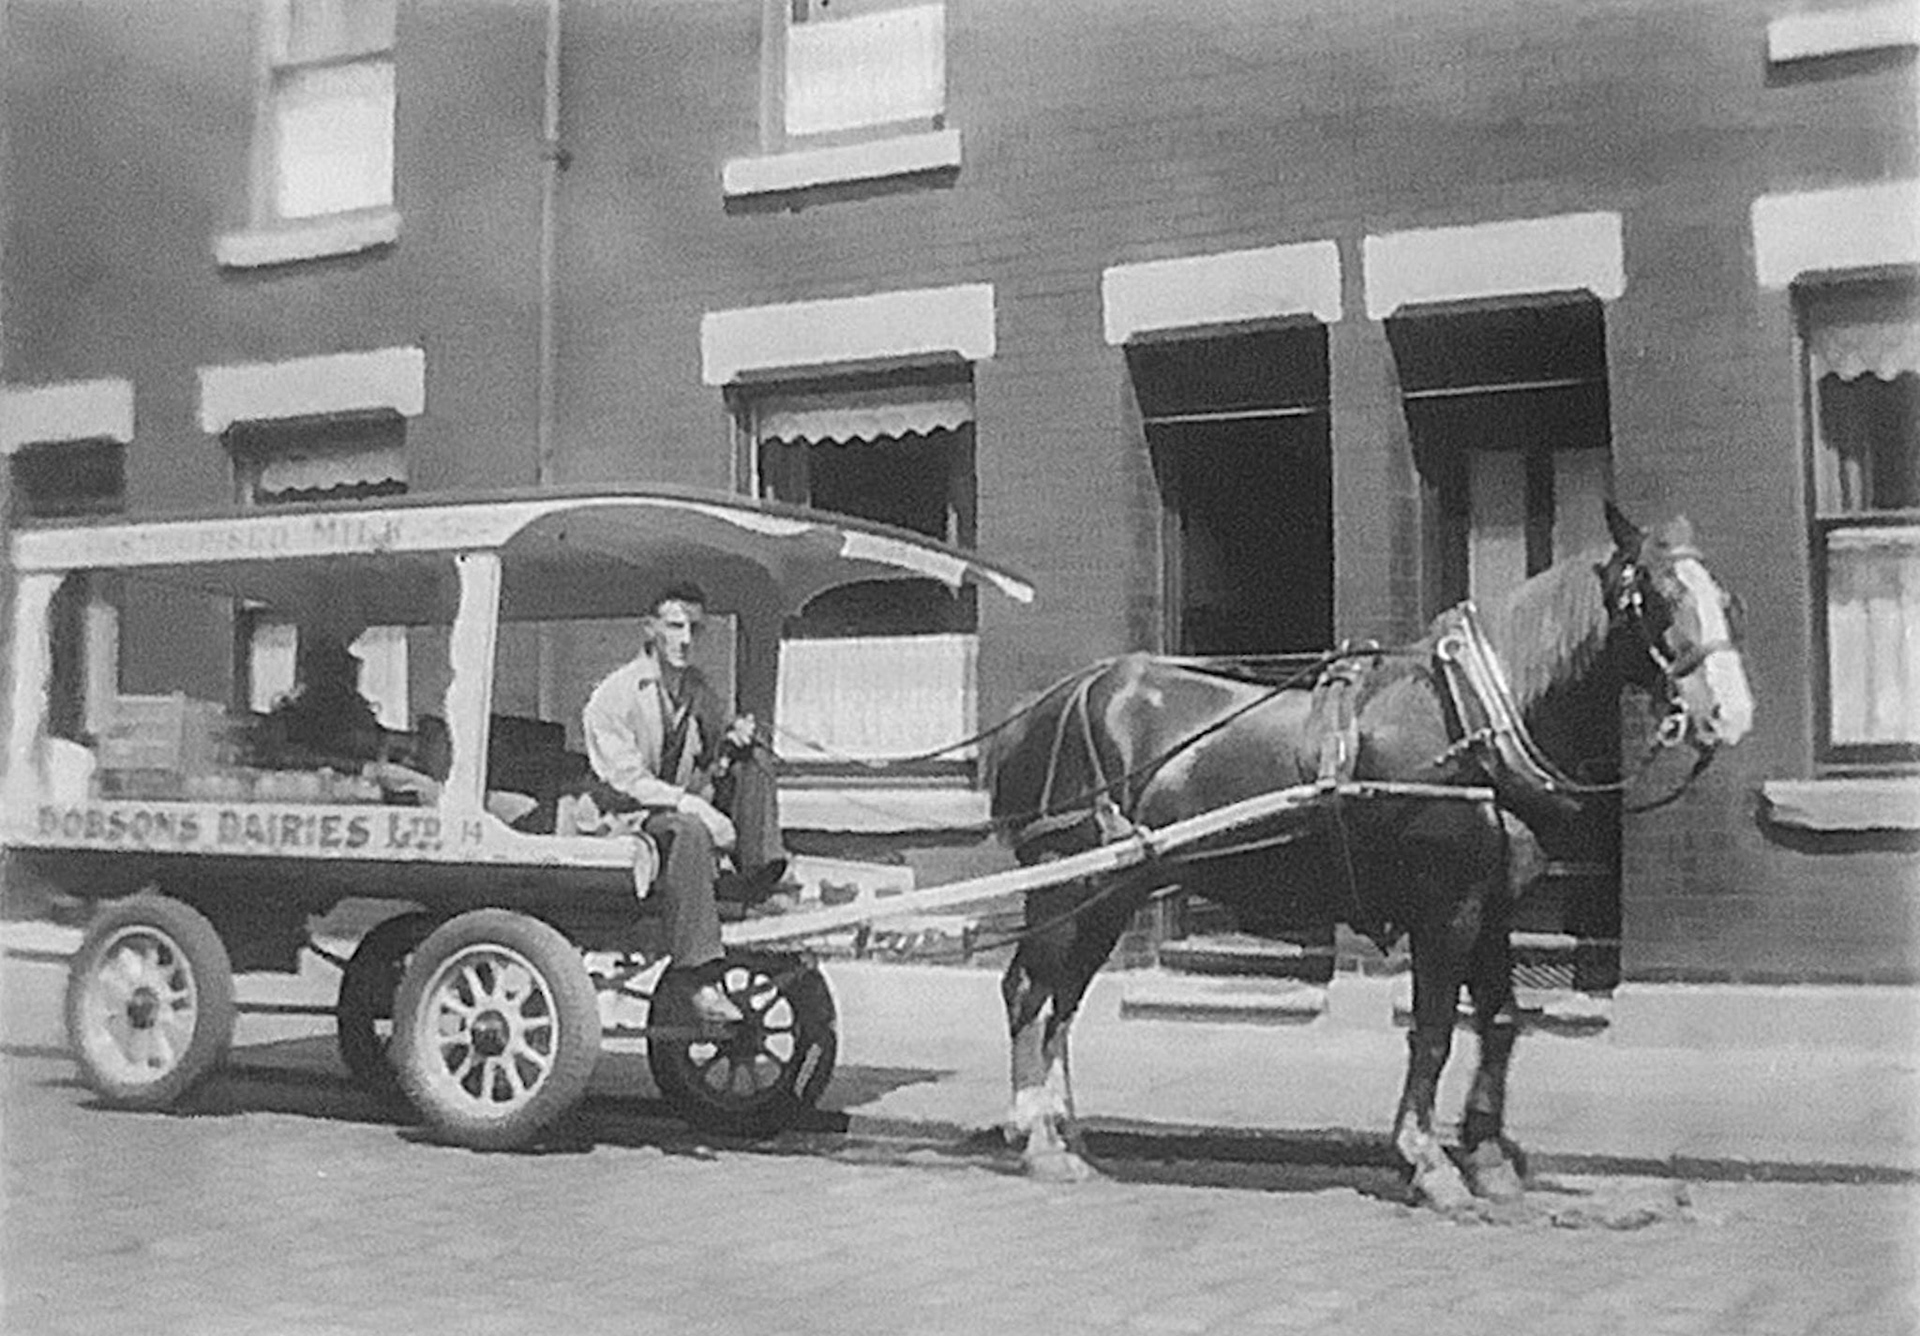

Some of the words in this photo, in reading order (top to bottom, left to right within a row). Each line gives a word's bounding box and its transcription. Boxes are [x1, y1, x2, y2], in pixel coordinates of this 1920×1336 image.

[313, 518, 403, 548] MILK
[38, 804, 199, 843] DOBSONS
[218, 809, 371, 849] DAIRIES
